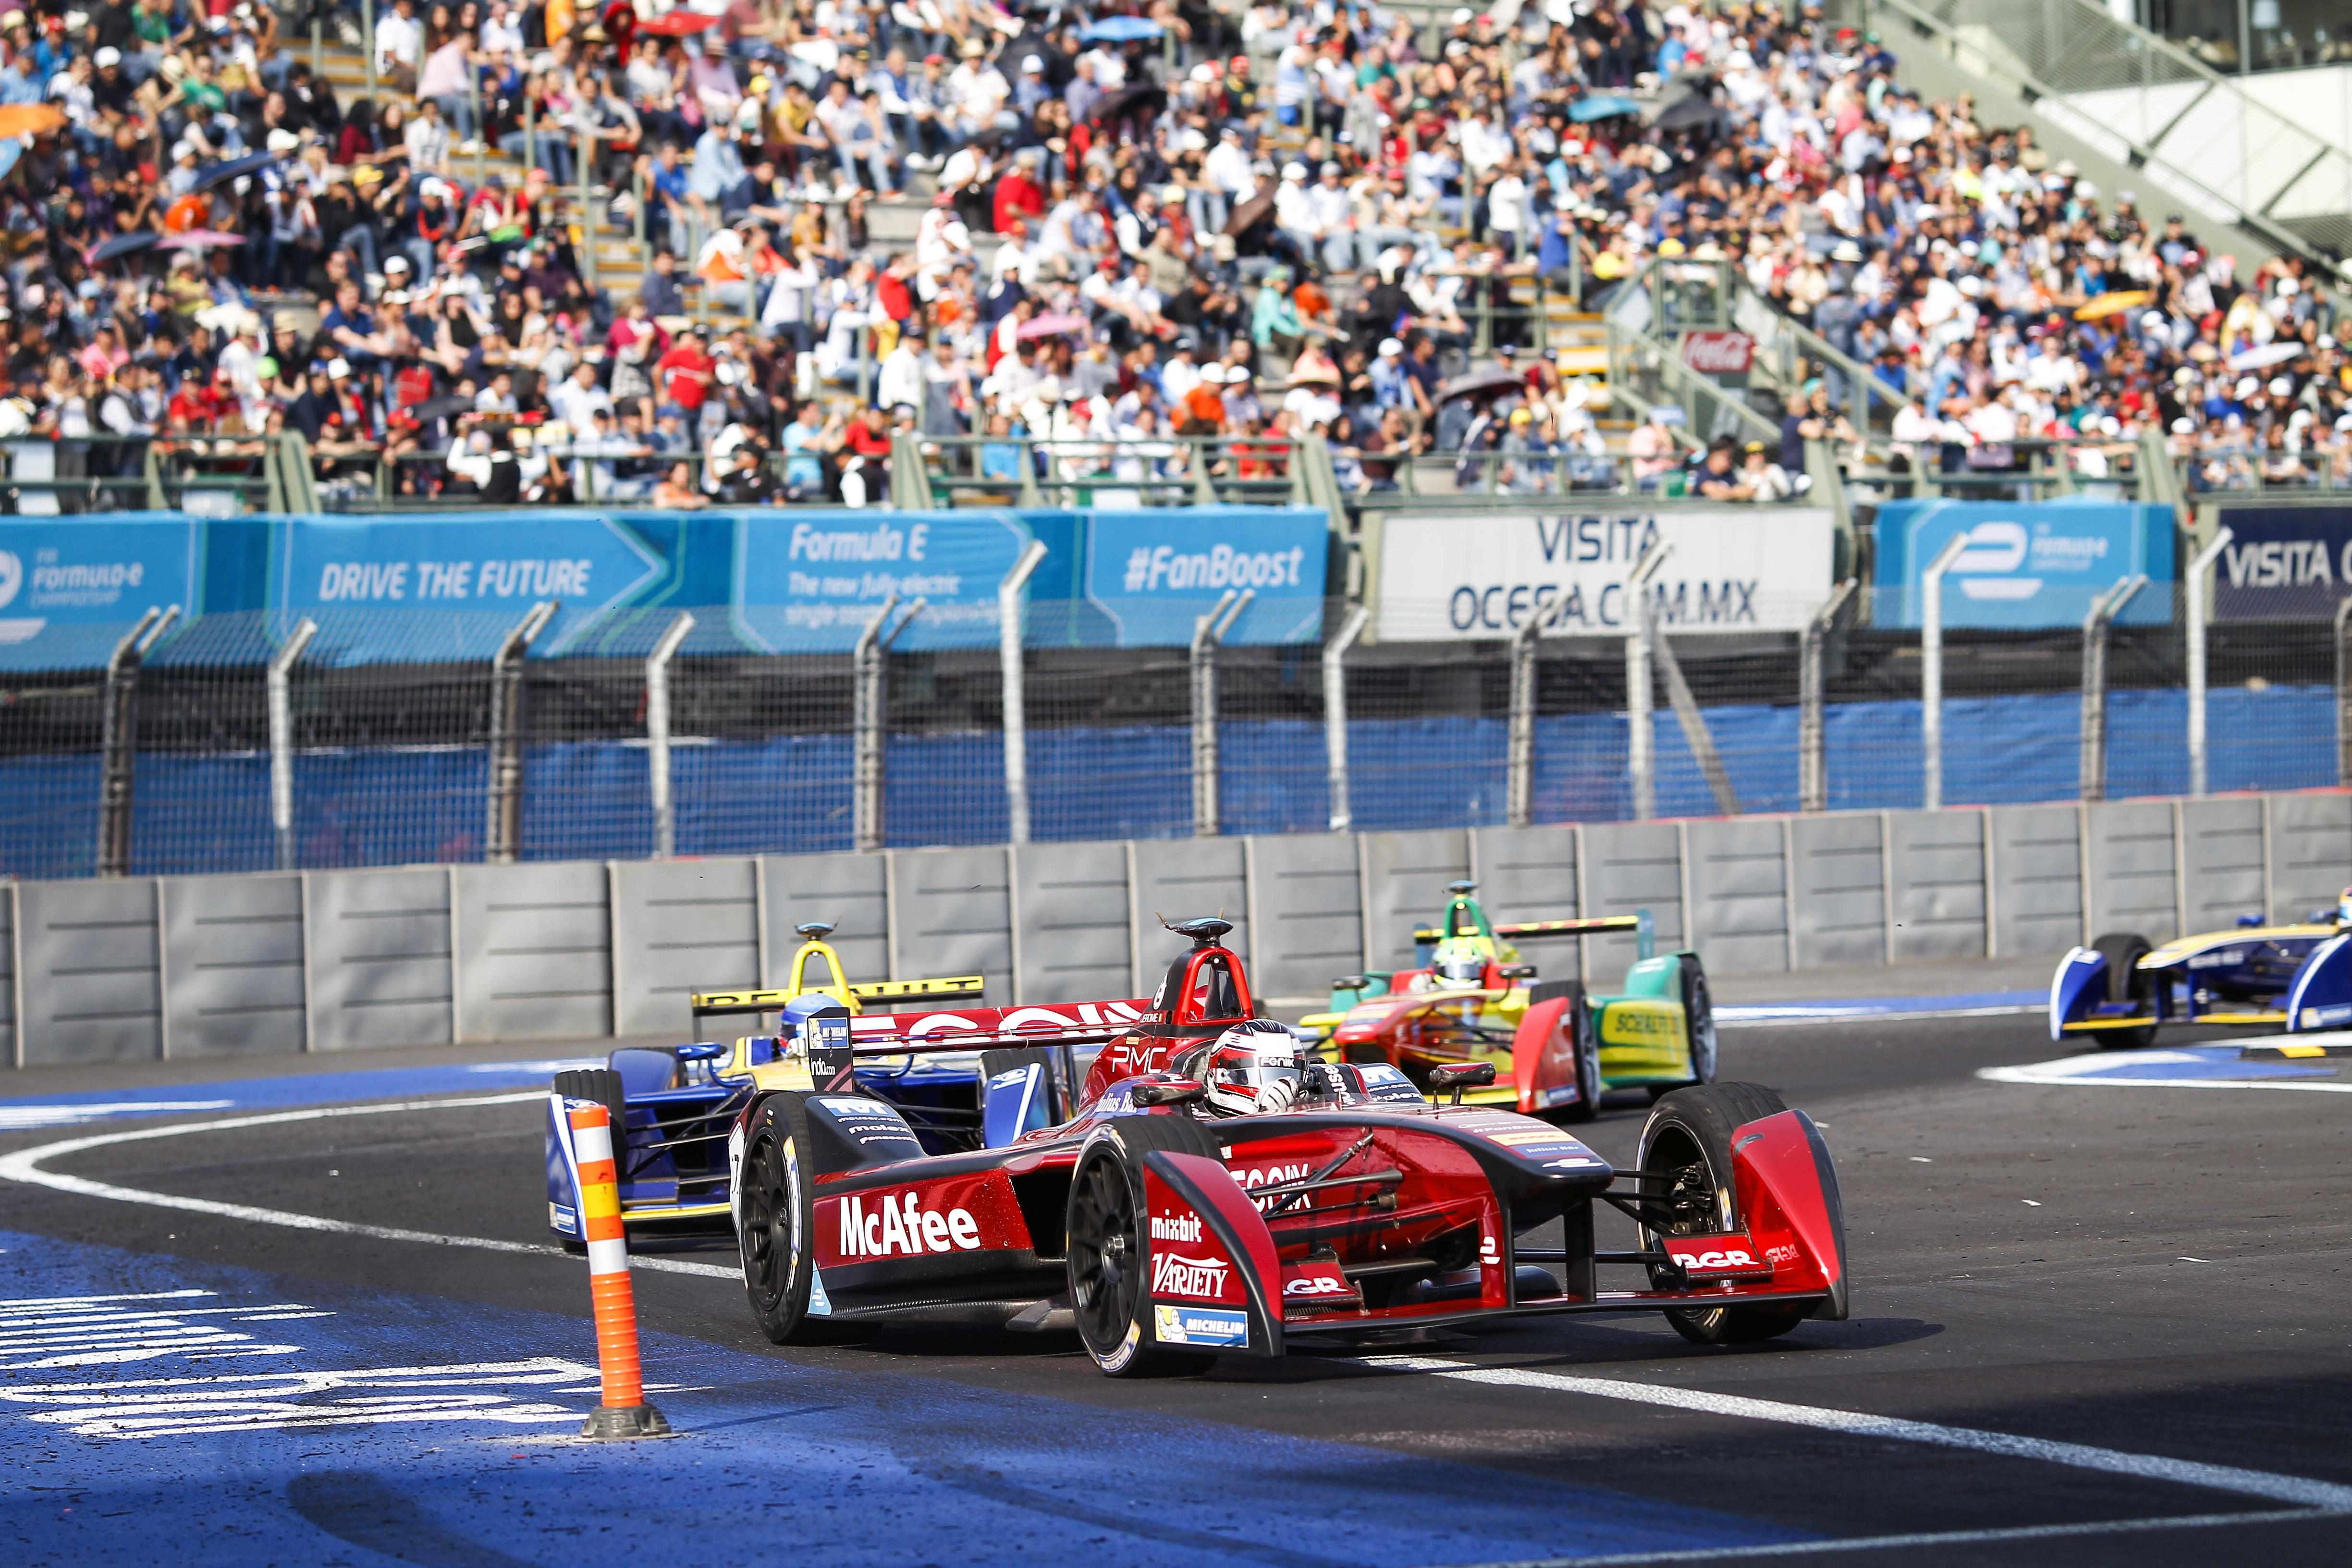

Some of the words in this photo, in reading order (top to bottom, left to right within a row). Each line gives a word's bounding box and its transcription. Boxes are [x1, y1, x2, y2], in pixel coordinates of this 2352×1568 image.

[787, 522, 904, 562] Formula
[907, 523, 930, 562] E
[1537, 516, 1662, 562] VISITA
[319, 562, 410, 601] DRIVE
[416, 561, 473, 599] THE
[477, 559, 593, 598] FUTURE
[1123, 543, 1304, 592] #FanBoost
[2224, 539, 2333, 588] VISITA
[1450, 579, 1758, 631] OCESA.CM.MX
[1112, 1046, 1167, 1074] PMC
[1090, 1091, 1121, 1117] Julius
[848, 1124, 911, 1135] molex
[840, 1191, 981, 1256] McAfee
[1151, 1209, 1202, 1243] mixbit
[1152, 1252, 1228, 1298] VARIETY
[1672, 1250, 1760, 1269] BGR
[1283, 1277, 1348, 1296] GR
[1186, 1318, 1245, 1335] MICHELIN
